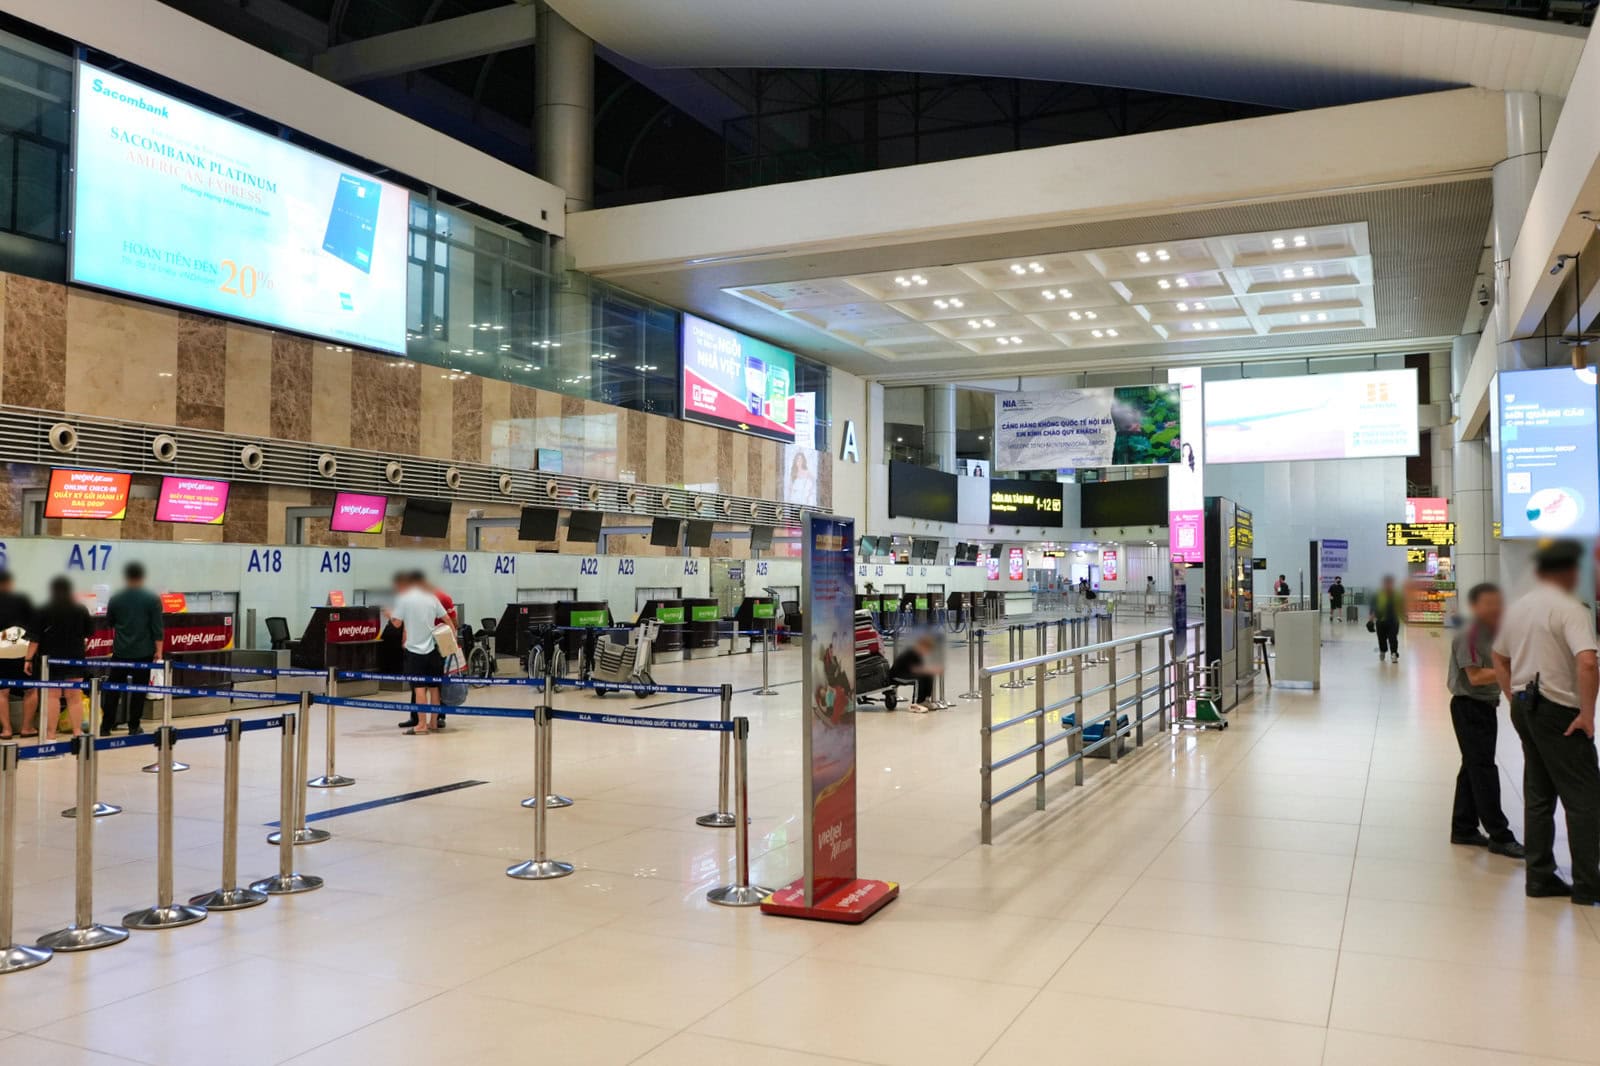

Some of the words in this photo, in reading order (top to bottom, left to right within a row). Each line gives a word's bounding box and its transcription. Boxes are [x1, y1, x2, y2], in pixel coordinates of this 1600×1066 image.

[92, 78, 168, 118] Sacombank
[110, 127, 206, 170] SACOMBANK
[210, 160, 278, 194] PLATINUM
[126, 149, 203, 185] AMERICAN
[208, 176, 263, 205] EXPRESS
[1002, 400, 1017, 409] NIA
[840, 419, 860, 464] A
[1036, 497, 1052, 511] 1-12
[67, 543, 113, 571] A17
[247, 549, 283, 573] A18
[319, 550, 351, 573] A19
[442, 554, 467, 574] A20
[494, 555, 516, 575] A21
[580, 558, 599, 576] A22
[617, 558, 635, 576] A23
[683, 560, 699, 576] A24
[755, 562, 768, 576] A25
